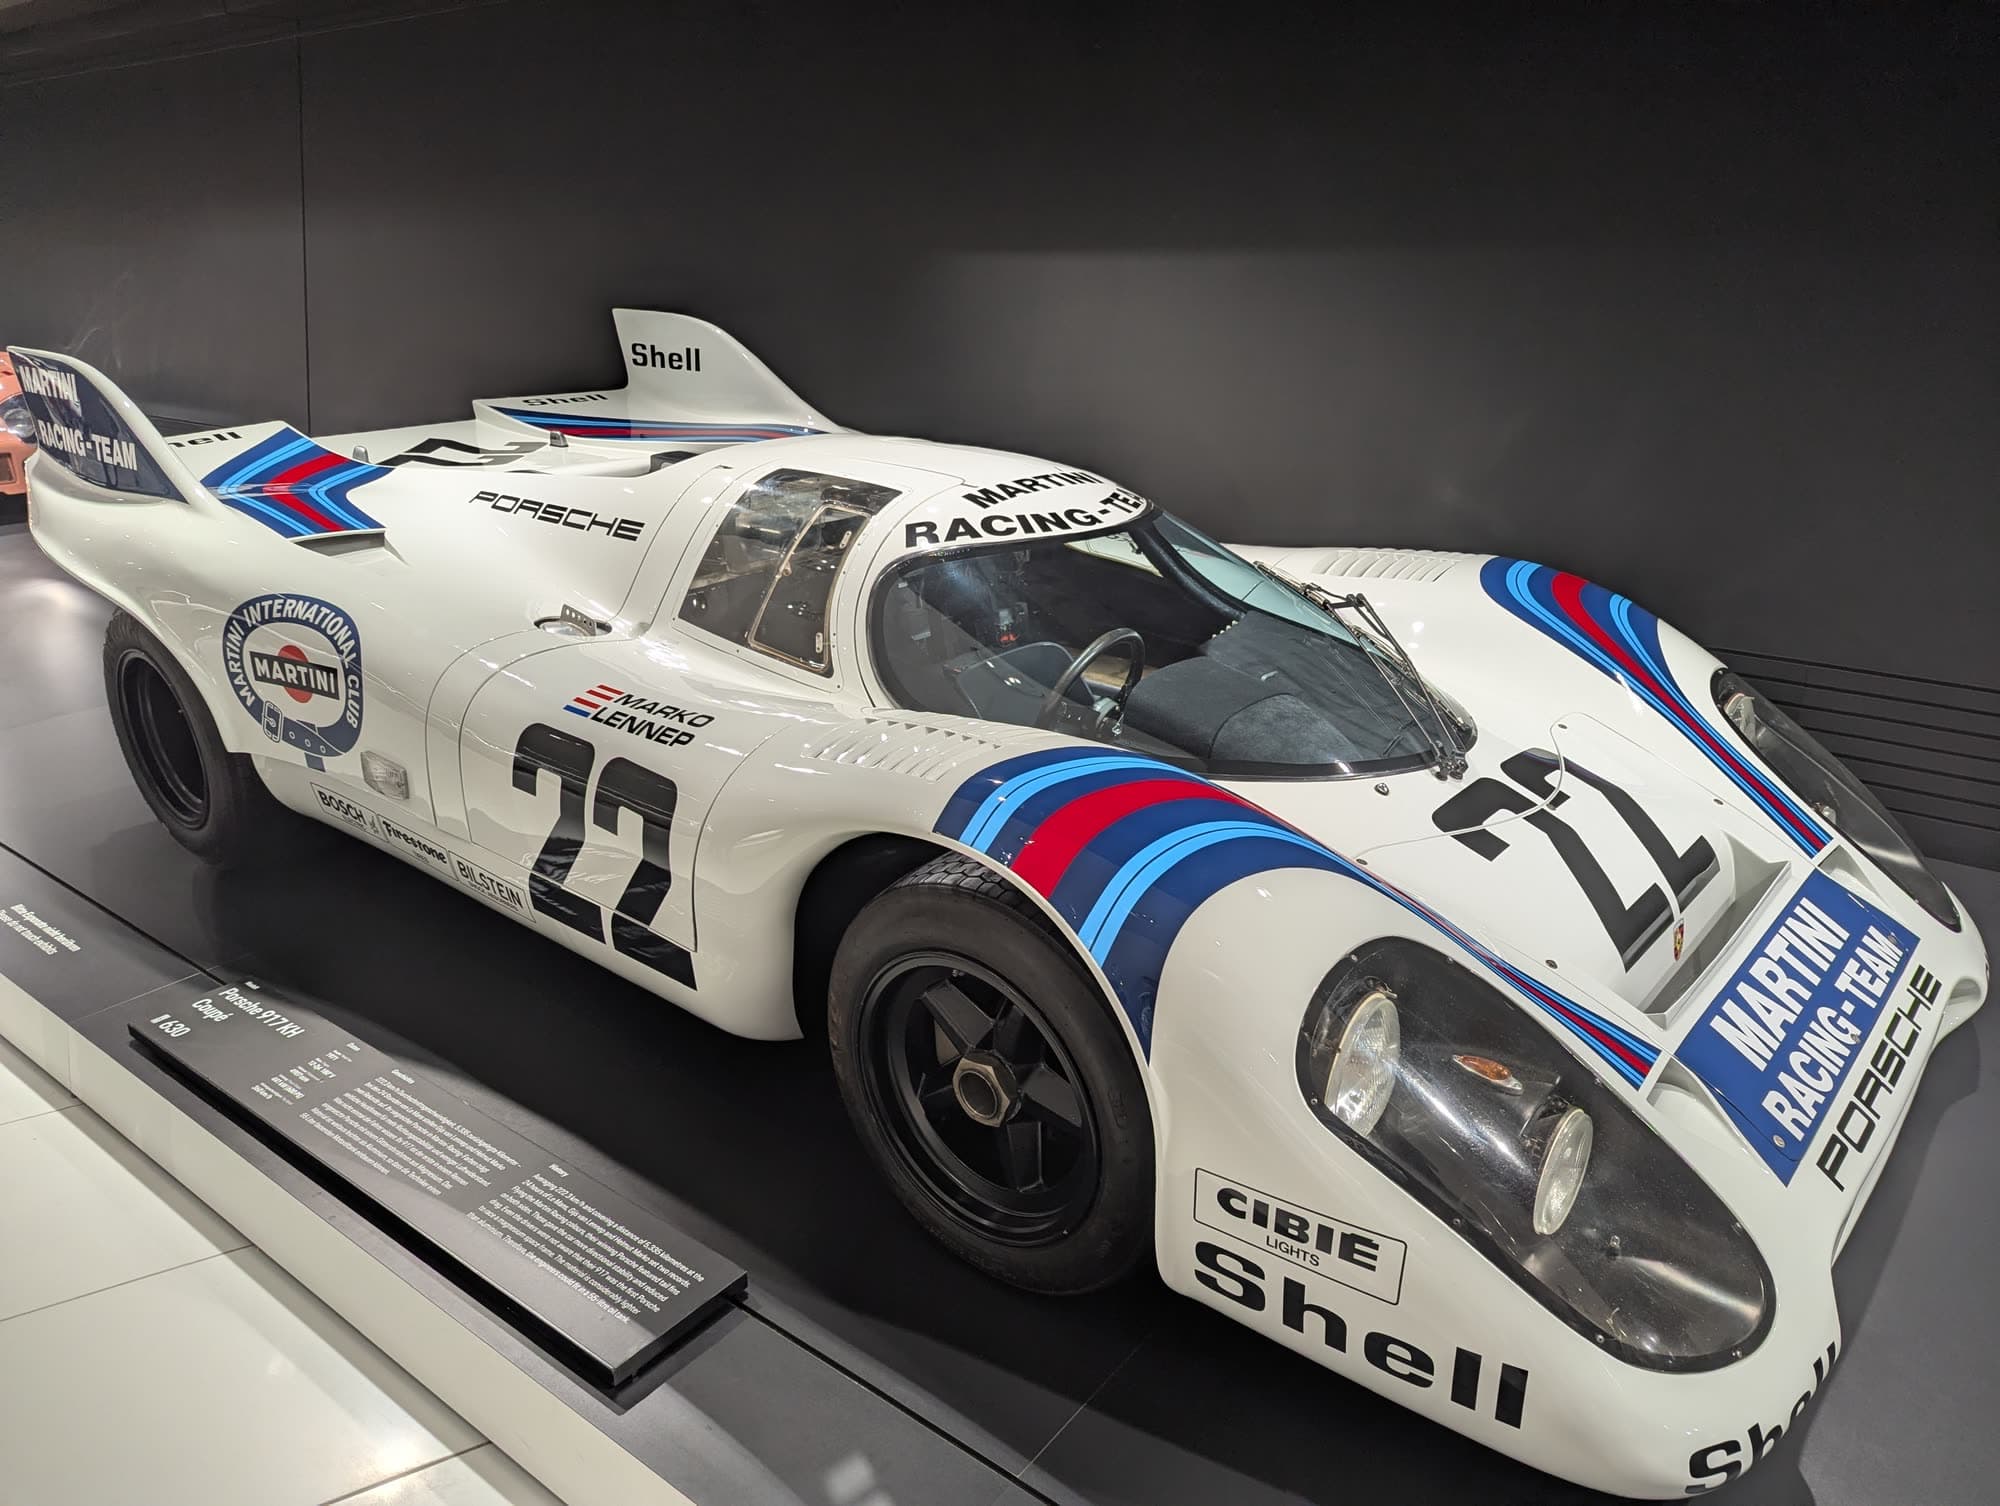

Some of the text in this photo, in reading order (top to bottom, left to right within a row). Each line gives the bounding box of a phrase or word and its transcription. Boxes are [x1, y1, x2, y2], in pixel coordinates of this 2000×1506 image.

[631, 343, 702, 373] Shell
[19, 365, 79, 402] MARTINI
[522, 393, 608, 407] Shell
[37, 419, 138, 472] RACING-TEAM
[962, 472, 1104, 509] MARTINI
[469, 490, 645, 542] PORSCHE
[227, 598, 360, 729] MARTINI INTERNATIONAL CLUB
[254, 656, 336, 694] MARTINI
[590, 706, 696, 747] LENNEP
[613, 693, 715, 728] MARKO
[317, 790, 367, 826] BOSCH
[382, 820, 448, 865] Firestone
[511, 722, 698, 992] 22
[1432, 747, 1721, 974] 22
[456, 860, 524, 909] BILSTEIN
[1709, 896, 1851, 1073] MARTINI
[158, 1020, 191, 1038] 630
[191, 998, 234, 1022] Coupé
[218, 987, 305, 1038] Porsche 917 KH
[1761, 924, 1904, 1144] RACING-TEAM
[1816, 964, 1942, 1192] PORSCHE
[1265, 1235, 1320, 1267] LIGHTS
[1194, 1240, 1529, 1430] Shell
